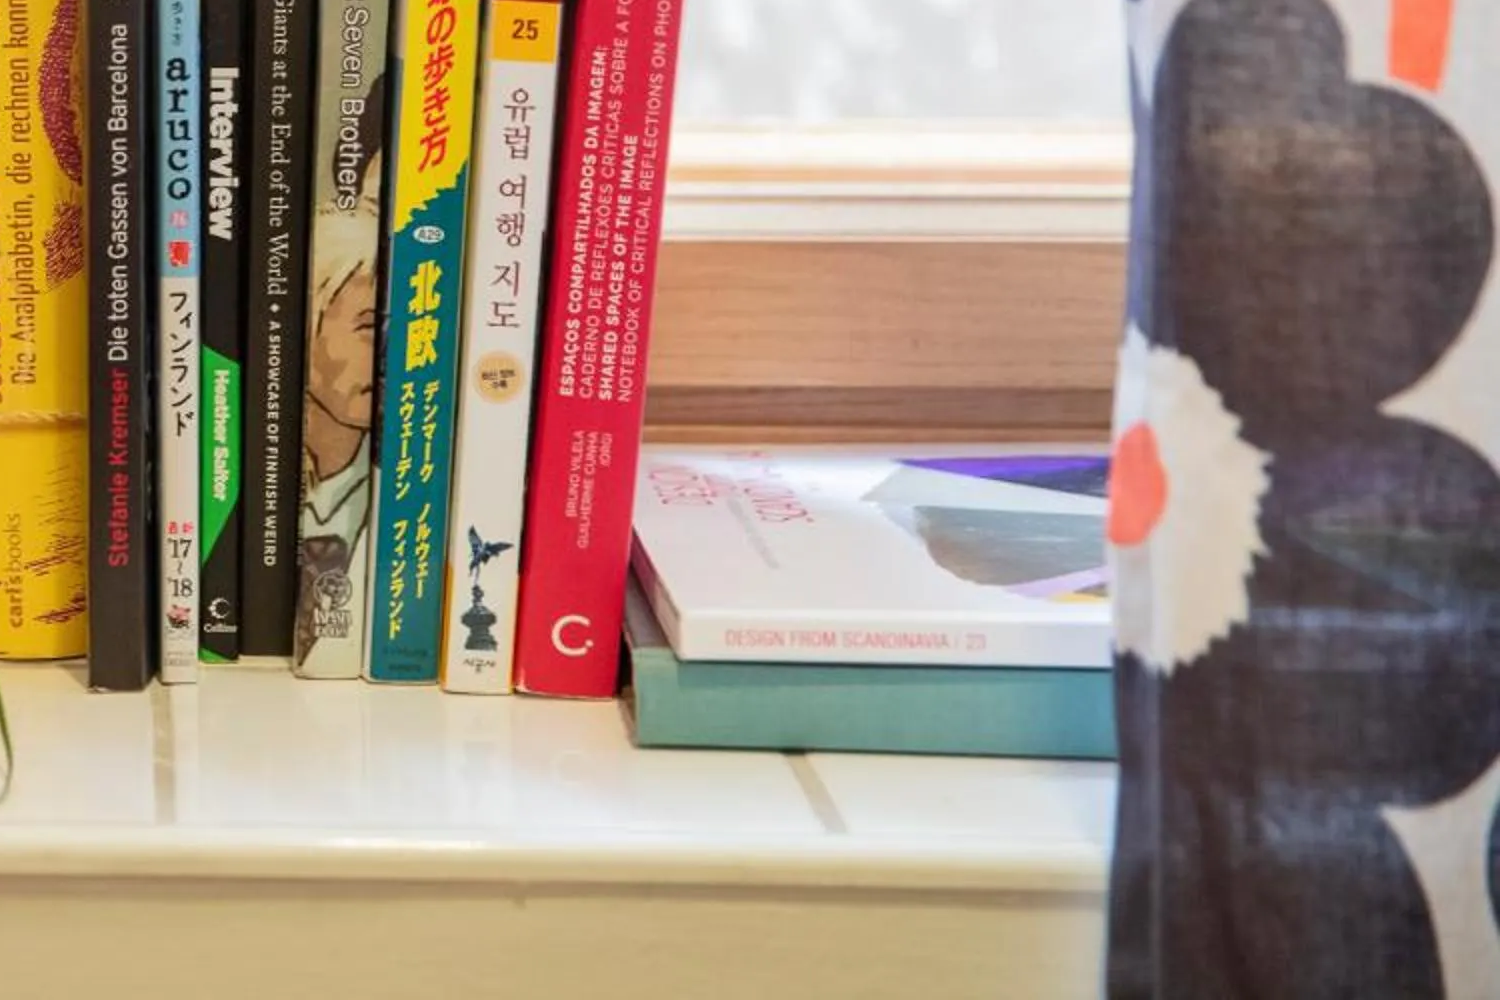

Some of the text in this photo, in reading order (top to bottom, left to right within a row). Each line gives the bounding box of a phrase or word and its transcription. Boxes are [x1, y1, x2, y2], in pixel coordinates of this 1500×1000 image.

[341, 4, 370, 89] Seven
[512, 19, 540, 41] 25
[615, 20, 630, 33] A
[651, 41, 668, 69] ON
[4, 57, 32, 143] rechnen
[270, 85, 293, 118] the
[271, 60, 288, 80] at
[608, 37, 629, 96] SOBRE
[165, 56, 193, 201] aruco
[209, 67, 240, 241] Interview
[270, 124, 293, 164] End
[335, 98, 366, 212] Brothers
[503, 87, 537, 161] 유럽
[583, 125, 600, 149] DA
[638, 72, 665, 191] REFLECTIONS
[6, 152, 33, 185] die
[268, 169, 291, 195] of
[268, 196, 290, 228] the
[496, 174, 528, 248] 여행
[567, 153, 598, 314] COMPARTILHADOS
[590, 183, 614, 281] REFLEXÕES
[630, 196, 653, 275] CRITICAL
[6, 193, 42, 344] Analphabetin,
[107, 23, 131, 568] Stefanie Kremser Die toten Gassen von Barcelona
[266, 232, 290, 296] World
[487, 260, 522, 329] 지도
[587, 287, 604, 310] DE
[598, 134, 639, 402] SHARED SPACES OF THE IMAGE
[627, 279, 643, 303] OF
[405, 259, 444, 372] 北欧
[10, 352, 38, 386] Die
[168, 292, 195, 438] フィンランド
[559, 318, 581, 397] ESPAÇOS
[579, 315, 601, 399] CADERNO
[617, 307, 641, 403] NOTEBOOK
[212, 369, 231, 444] Heather
[263, 320, 282, 567] A SHOWCASE OF FINNISH WEIRD
[419, 379, 440, 484] デンマーク
[564, 430, 586, 518] BRUNO VILELA
[576, 431, 599, 549] GUILHERME CUNHA
[167, 539, 193, 559] '17
[167, 577, 194, 598] '18
[725, 629, 784, 648] DESIGN
[789, 630, 837, 648] FROM
[842, 631, 950, 649] SCANDINAVIA
